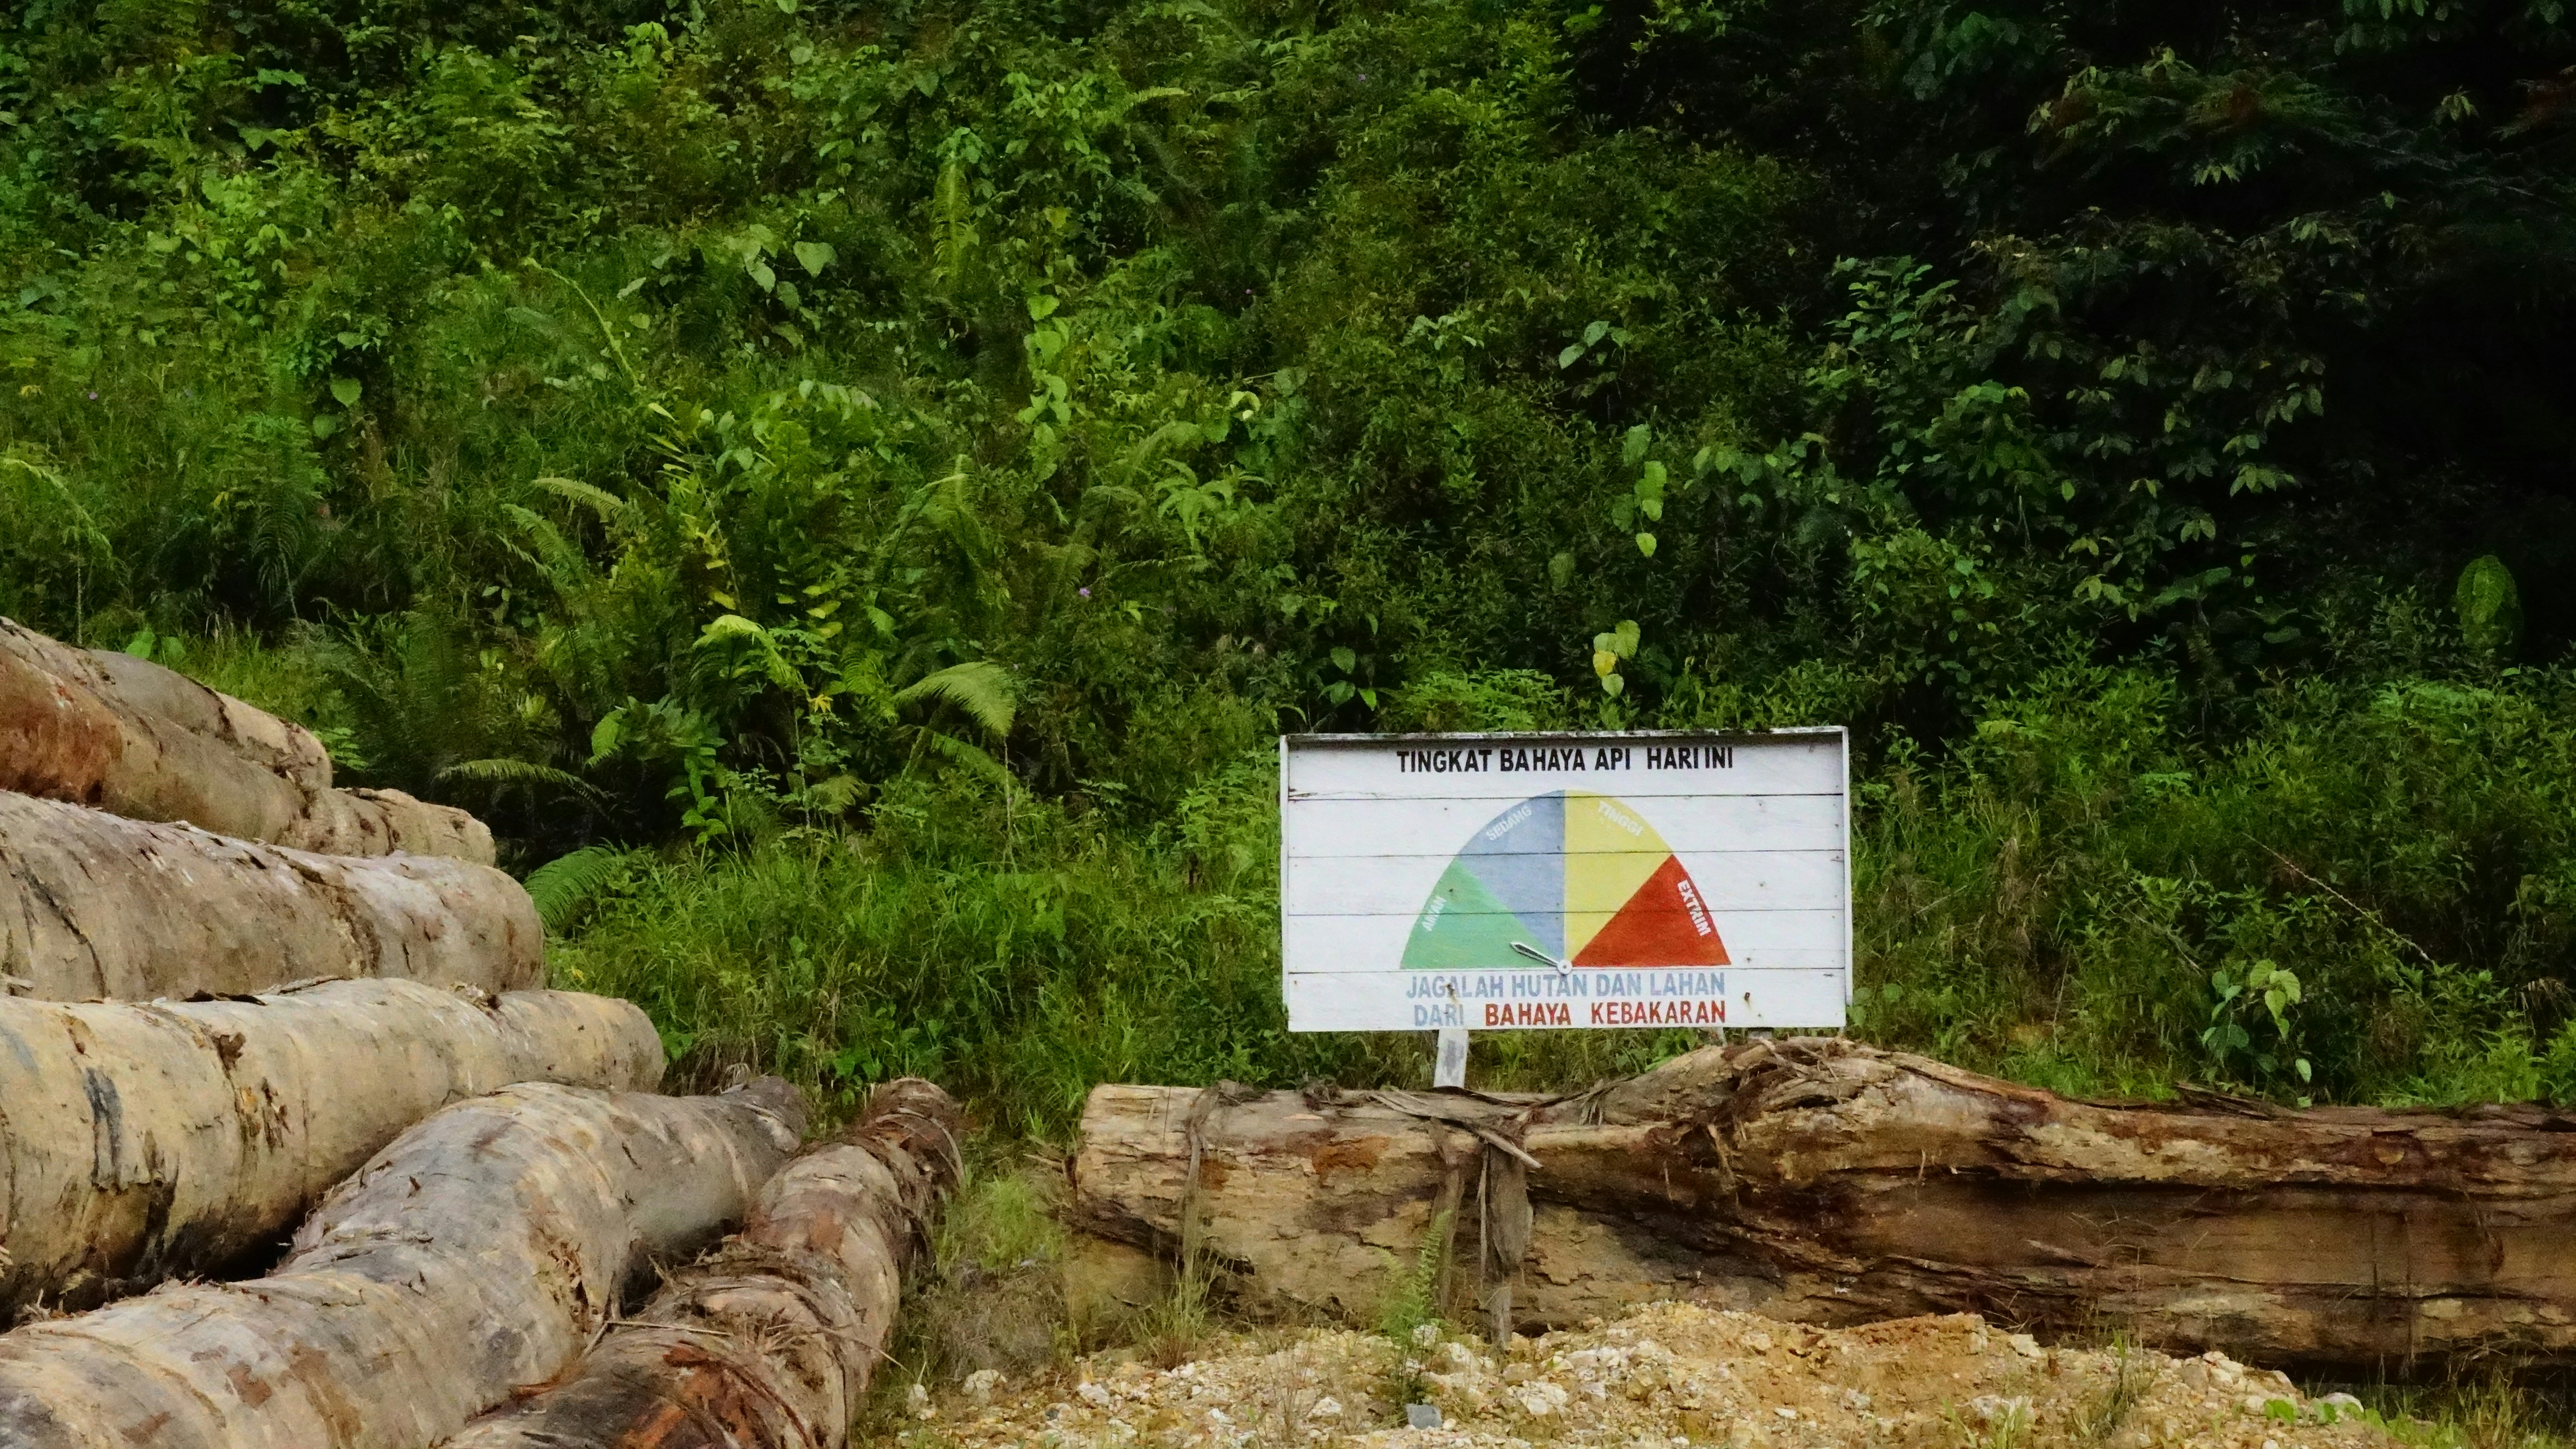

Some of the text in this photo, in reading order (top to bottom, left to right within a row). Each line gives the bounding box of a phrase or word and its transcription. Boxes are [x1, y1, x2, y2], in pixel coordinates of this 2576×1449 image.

[1397, 747, 1733, 773] TINGKAT BAHAYA API HARI INI
[1486, 803, 1532, 841] SEDANG
[1598, 800, 1644, 836] TINGGI
[1677, 879, 1711, 936] EXTRIM
[1406, 972, 1725, 999] JAGALAH HUTAN DAN LAHAN
[1414, 1000, 1726, 1027] DARI BAHAYA KEBAKARAN
